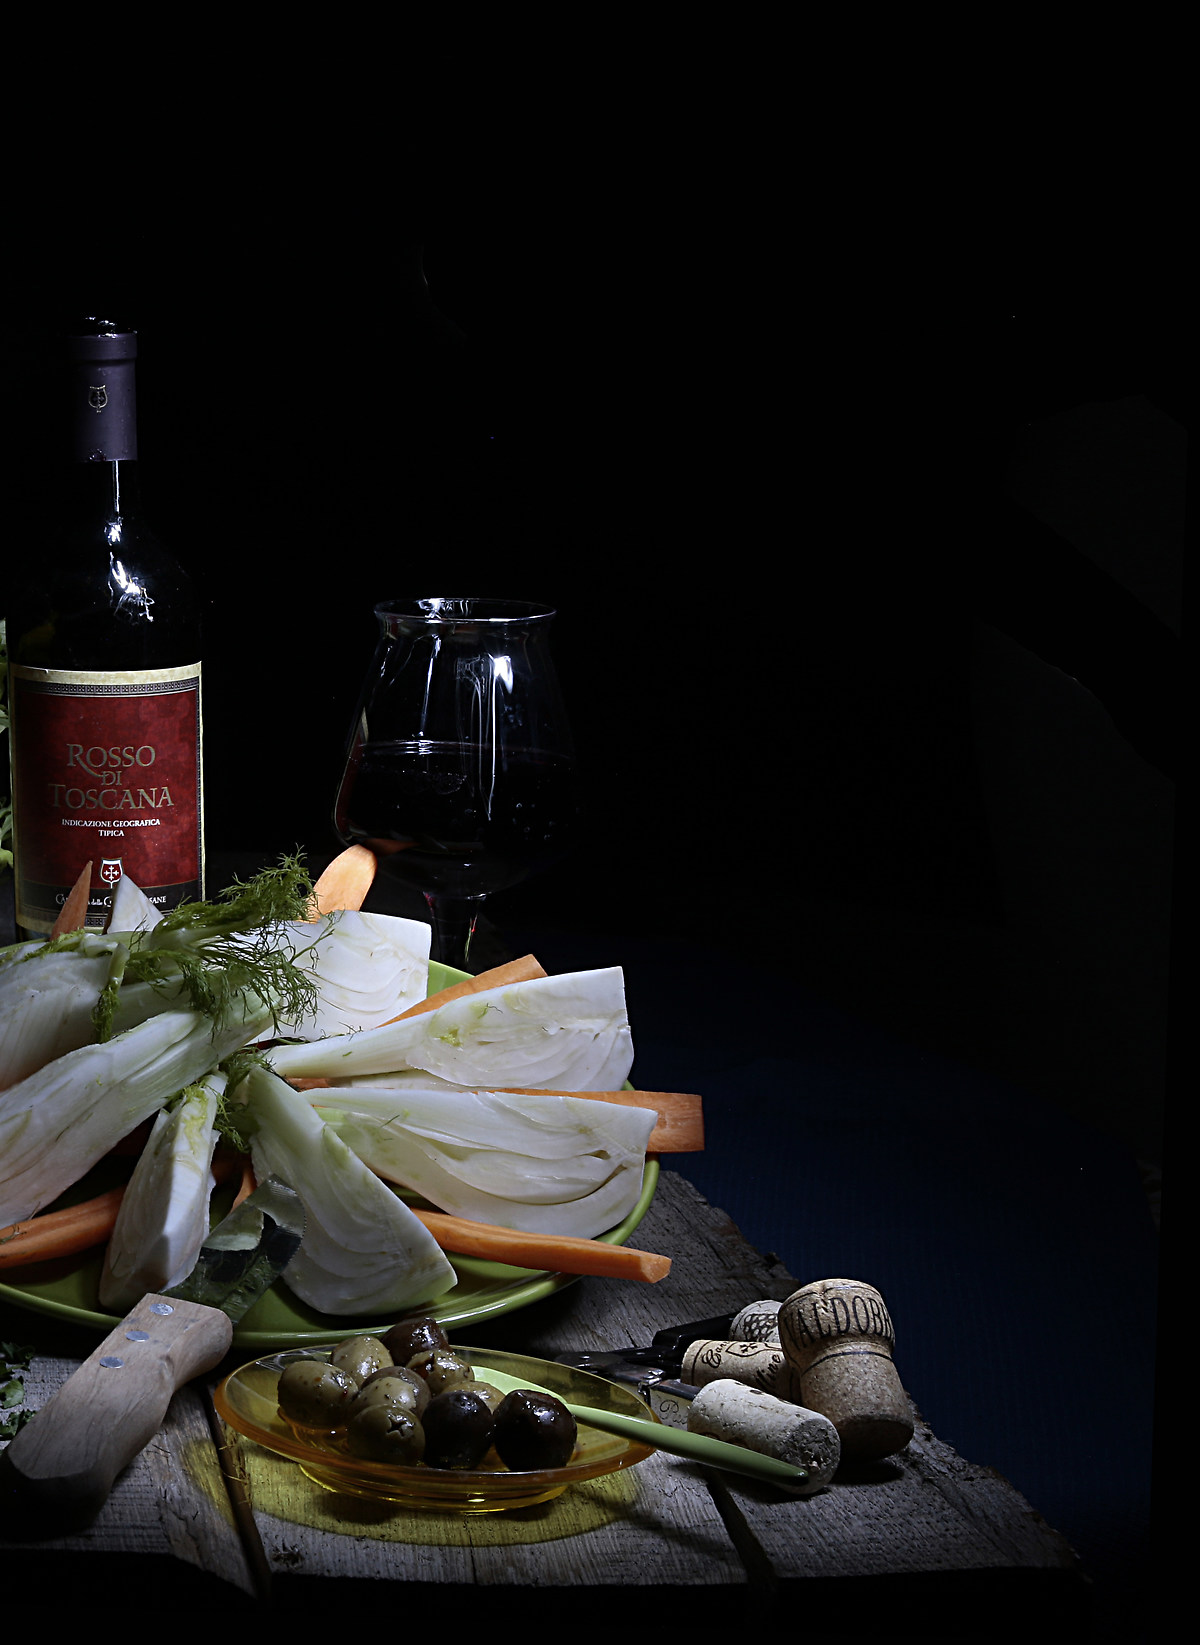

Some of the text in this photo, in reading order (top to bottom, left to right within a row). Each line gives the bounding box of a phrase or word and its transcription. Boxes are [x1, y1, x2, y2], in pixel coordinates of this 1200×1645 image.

[66, 743, 156, 777] ROSSO
[100, 770, 122, 786] DI
[48, 783, 175, 810] TOSCANA
[61, 818, 161, 828] INDICAZIONE GEOGRAFICA
[98, 829, 125, 837] TIPICA
